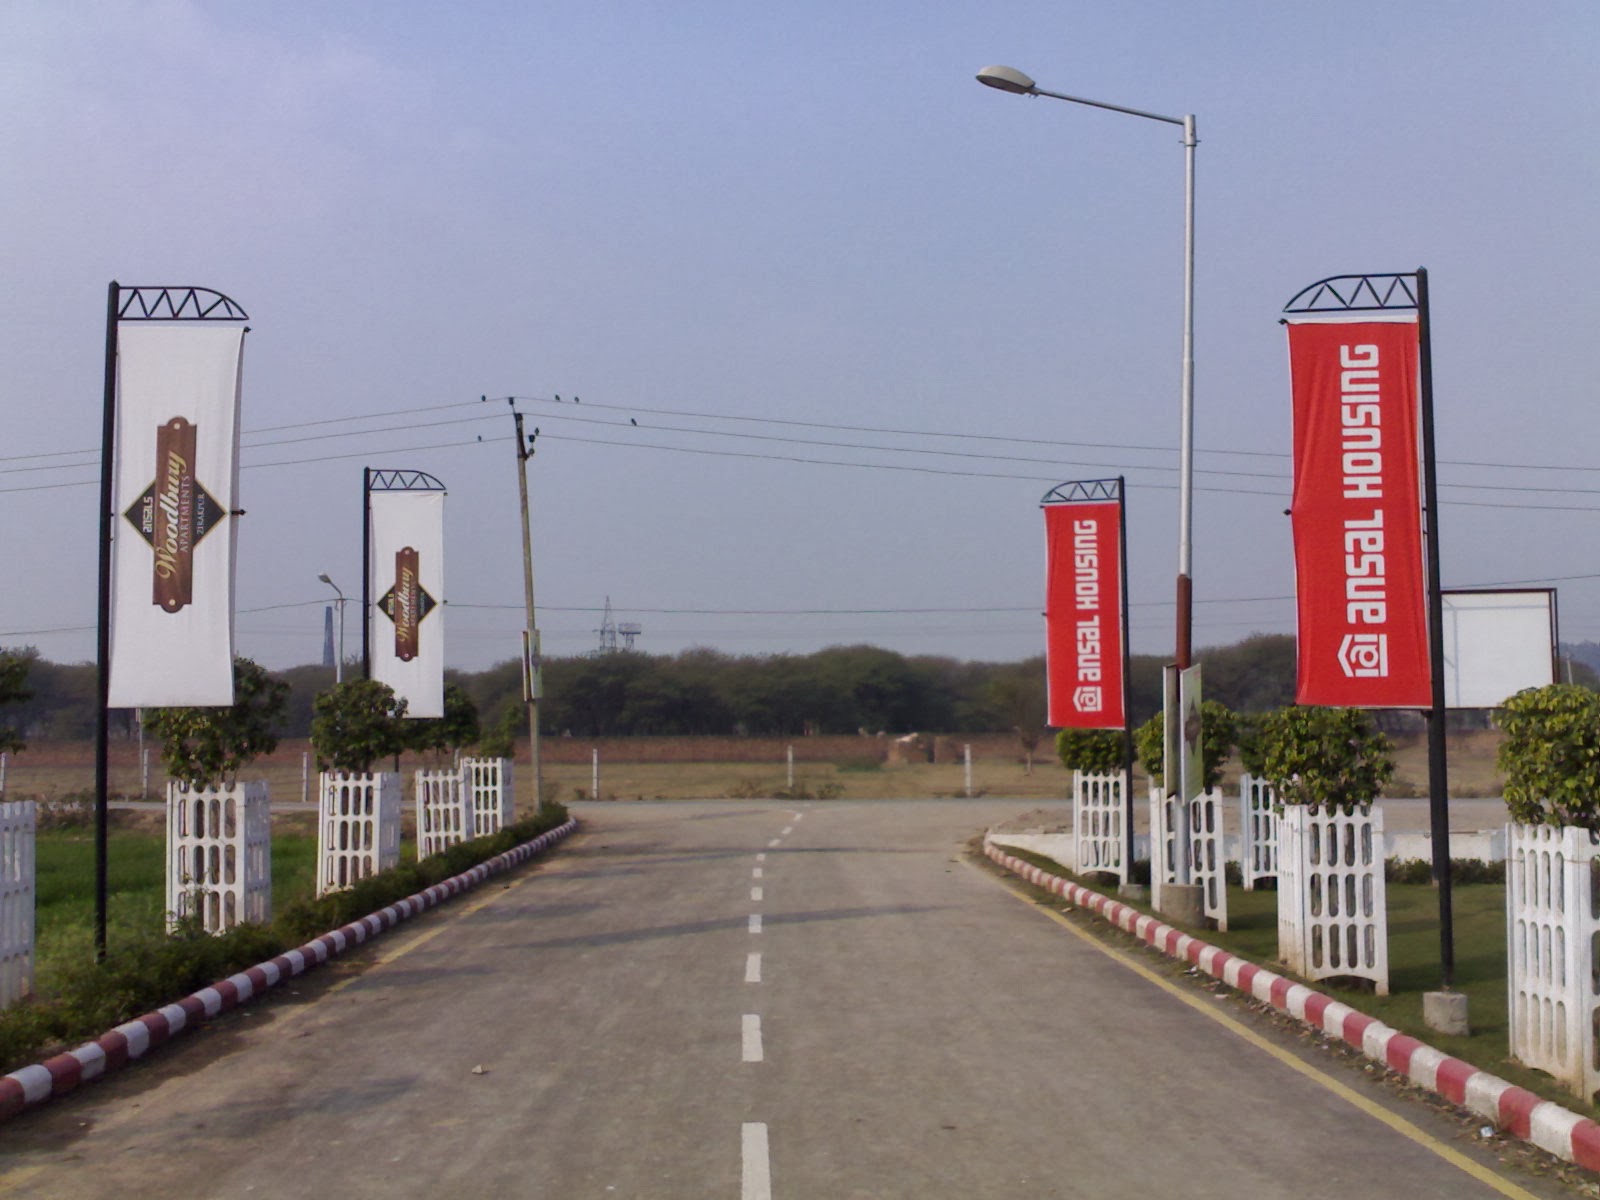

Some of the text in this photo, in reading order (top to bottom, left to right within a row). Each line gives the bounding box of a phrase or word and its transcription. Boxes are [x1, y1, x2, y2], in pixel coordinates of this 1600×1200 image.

[156, 451, 187, 579] Woodbury
[179, 475, 190, 553] APARTMENTS
[397, 567, 413, 642] Woodbury
